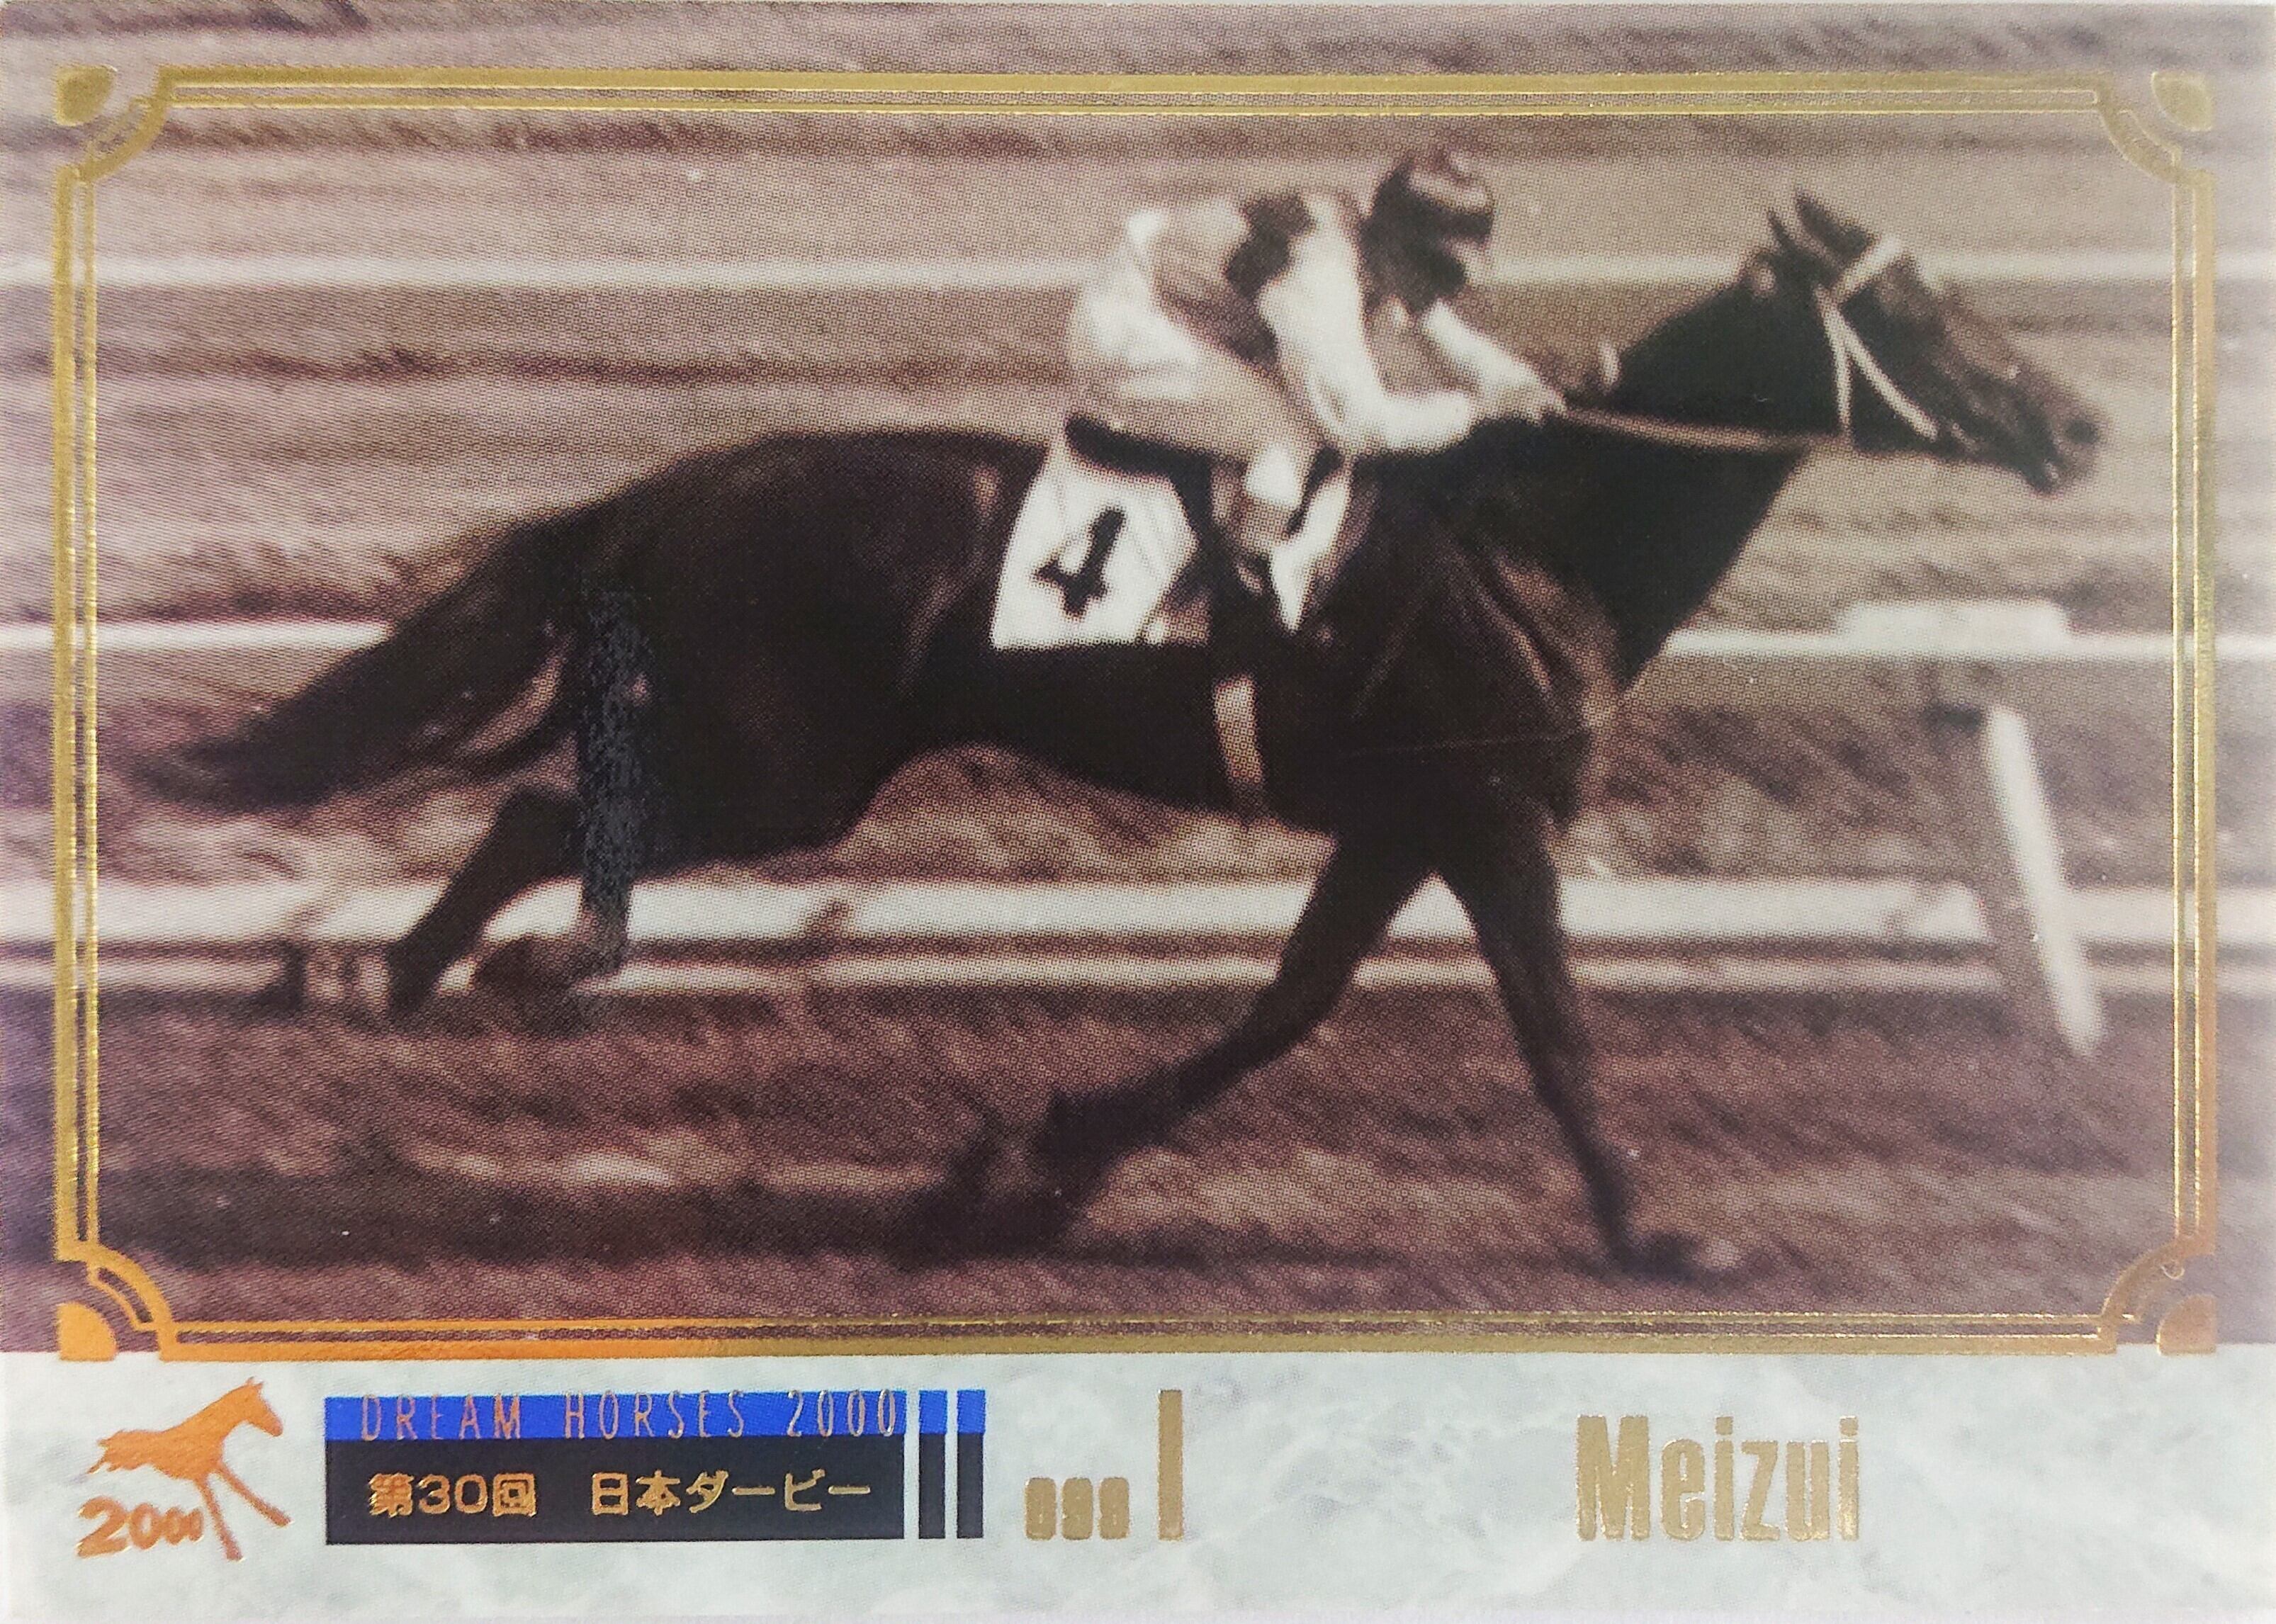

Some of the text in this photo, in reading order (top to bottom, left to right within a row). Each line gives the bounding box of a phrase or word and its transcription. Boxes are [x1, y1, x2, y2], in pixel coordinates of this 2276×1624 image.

[1032, 504, 1127, 615] 4
[361, 1388, 896, 1441] DREAM HORSES 2000
[368, 1468, 872, 1517] 第30回 日本ダービー
[1575, 1414, 1859, 1541] Meizui
[77, 1494, 205, 1558] 2000
